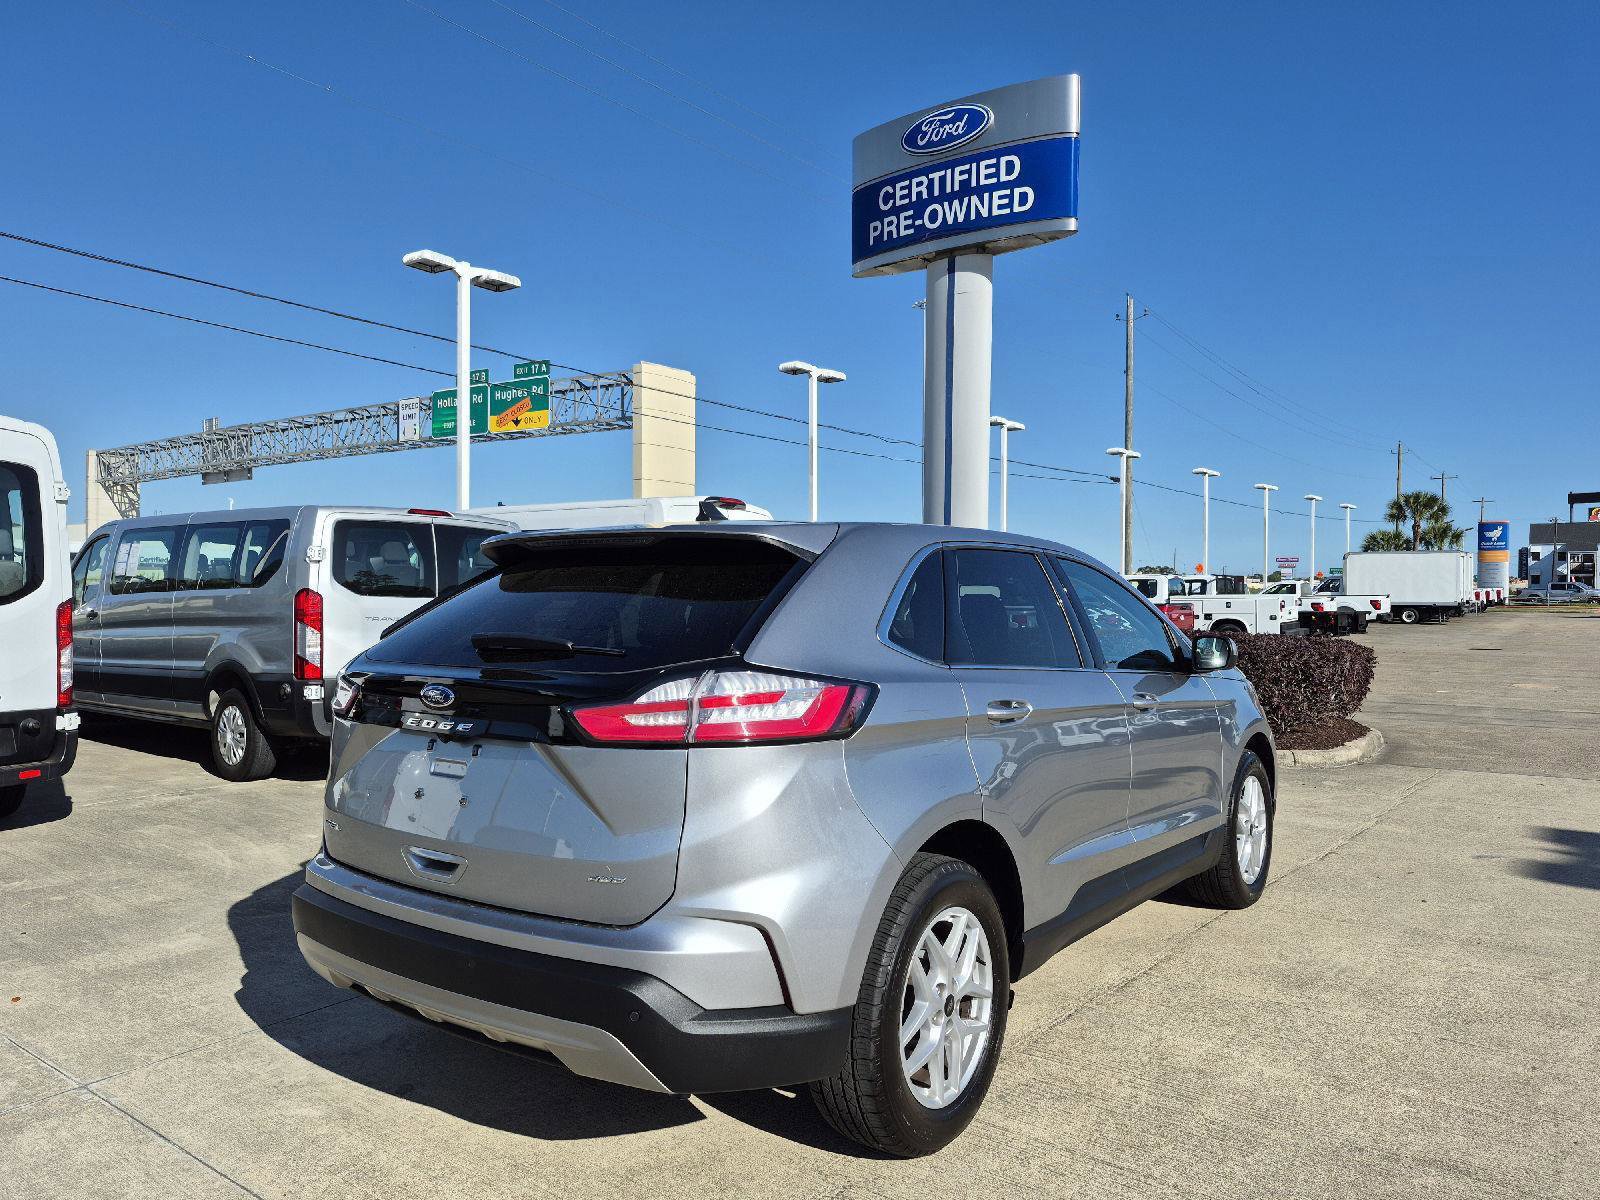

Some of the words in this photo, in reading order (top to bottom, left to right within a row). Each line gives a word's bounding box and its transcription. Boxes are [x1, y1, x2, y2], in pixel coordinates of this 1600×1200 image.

[917, 111, 969, 146] Ford
[878, 155, 1021, 211] CERTIFIED
[869, 186, 1035, 246] PRE-OWNED
[531, 364, 539, 374] 17
[540, 365, 547, 373] A
[472, 373, 480, 381] 17
[495, 388, 528, 402] Hughes
[532, 384, 543, 396] Rd
[401, 402, 419, 411] SPEED
[437, 397, 458, 409] Holla
[472, 393, 483, 404] Rd
[403, 413, 417, 421] LIMIT
[524, 415, 542, 425] ONLY
[406, 717, 474, 732] EDGE
